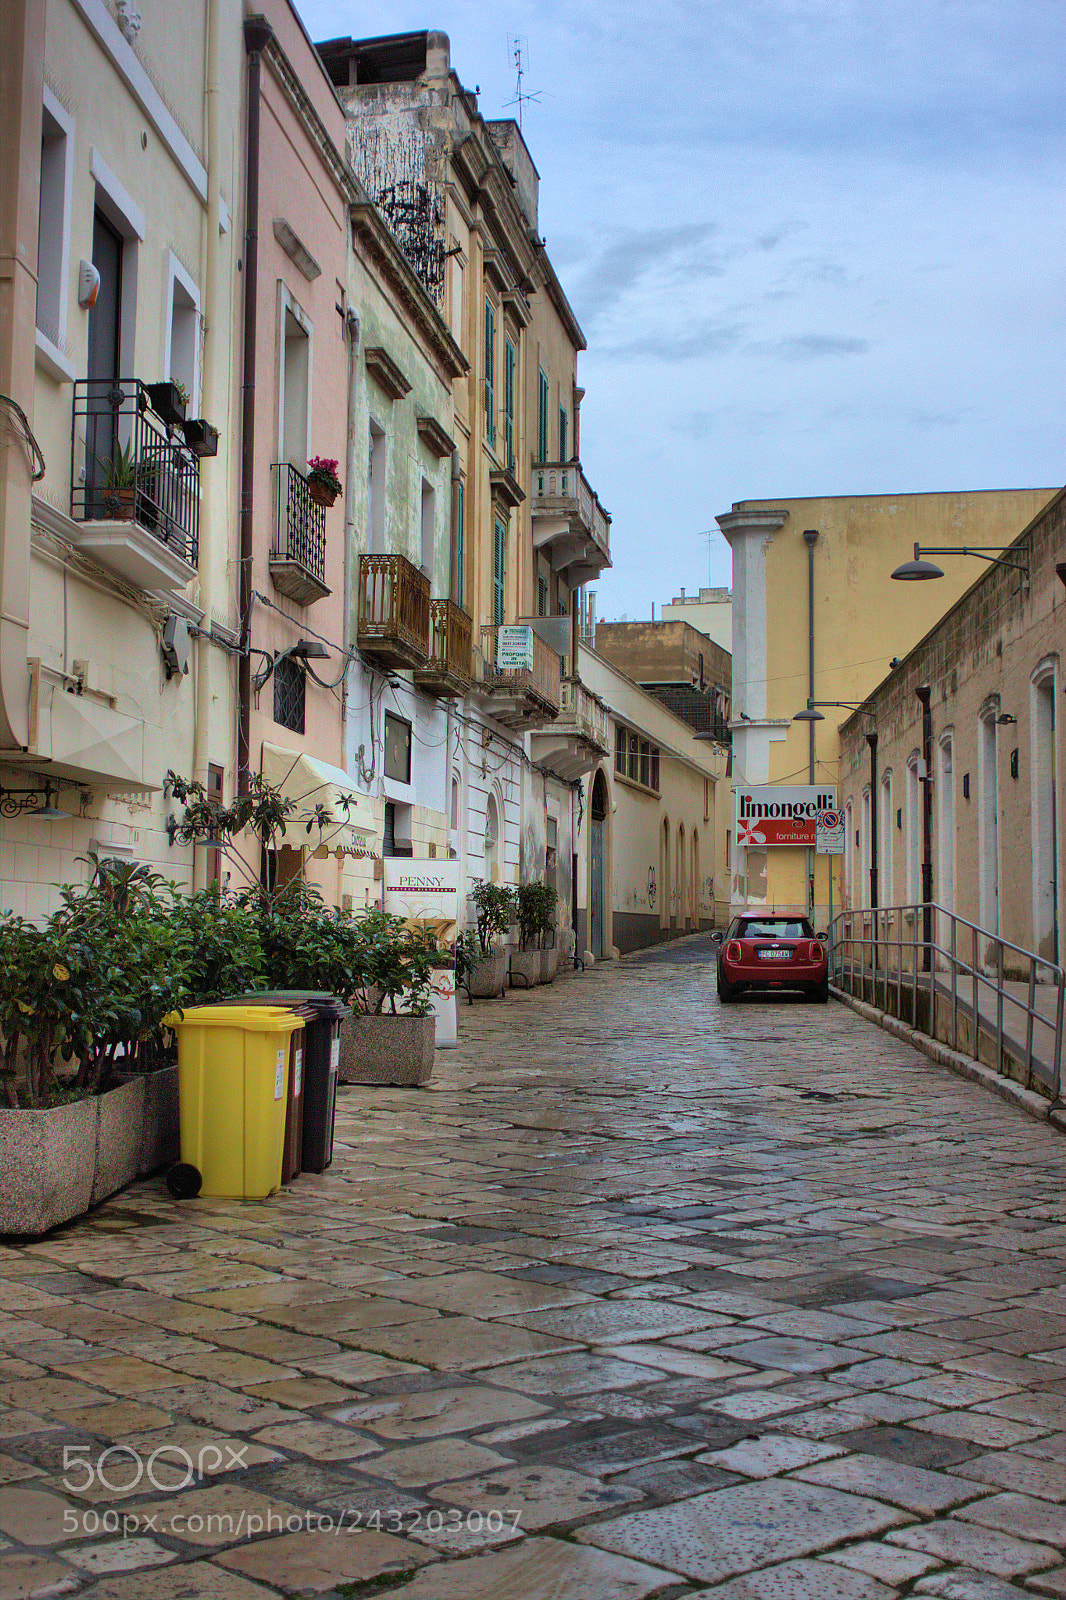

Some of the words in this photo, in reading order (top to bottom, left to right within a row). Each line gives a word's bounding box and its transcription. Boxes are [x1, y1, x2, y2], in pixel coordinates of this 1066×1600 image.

[740, 794, 834, 829] limongelli
[776, 832, 809, 840] forniture
[399, 876, 445, 886] PENNY
